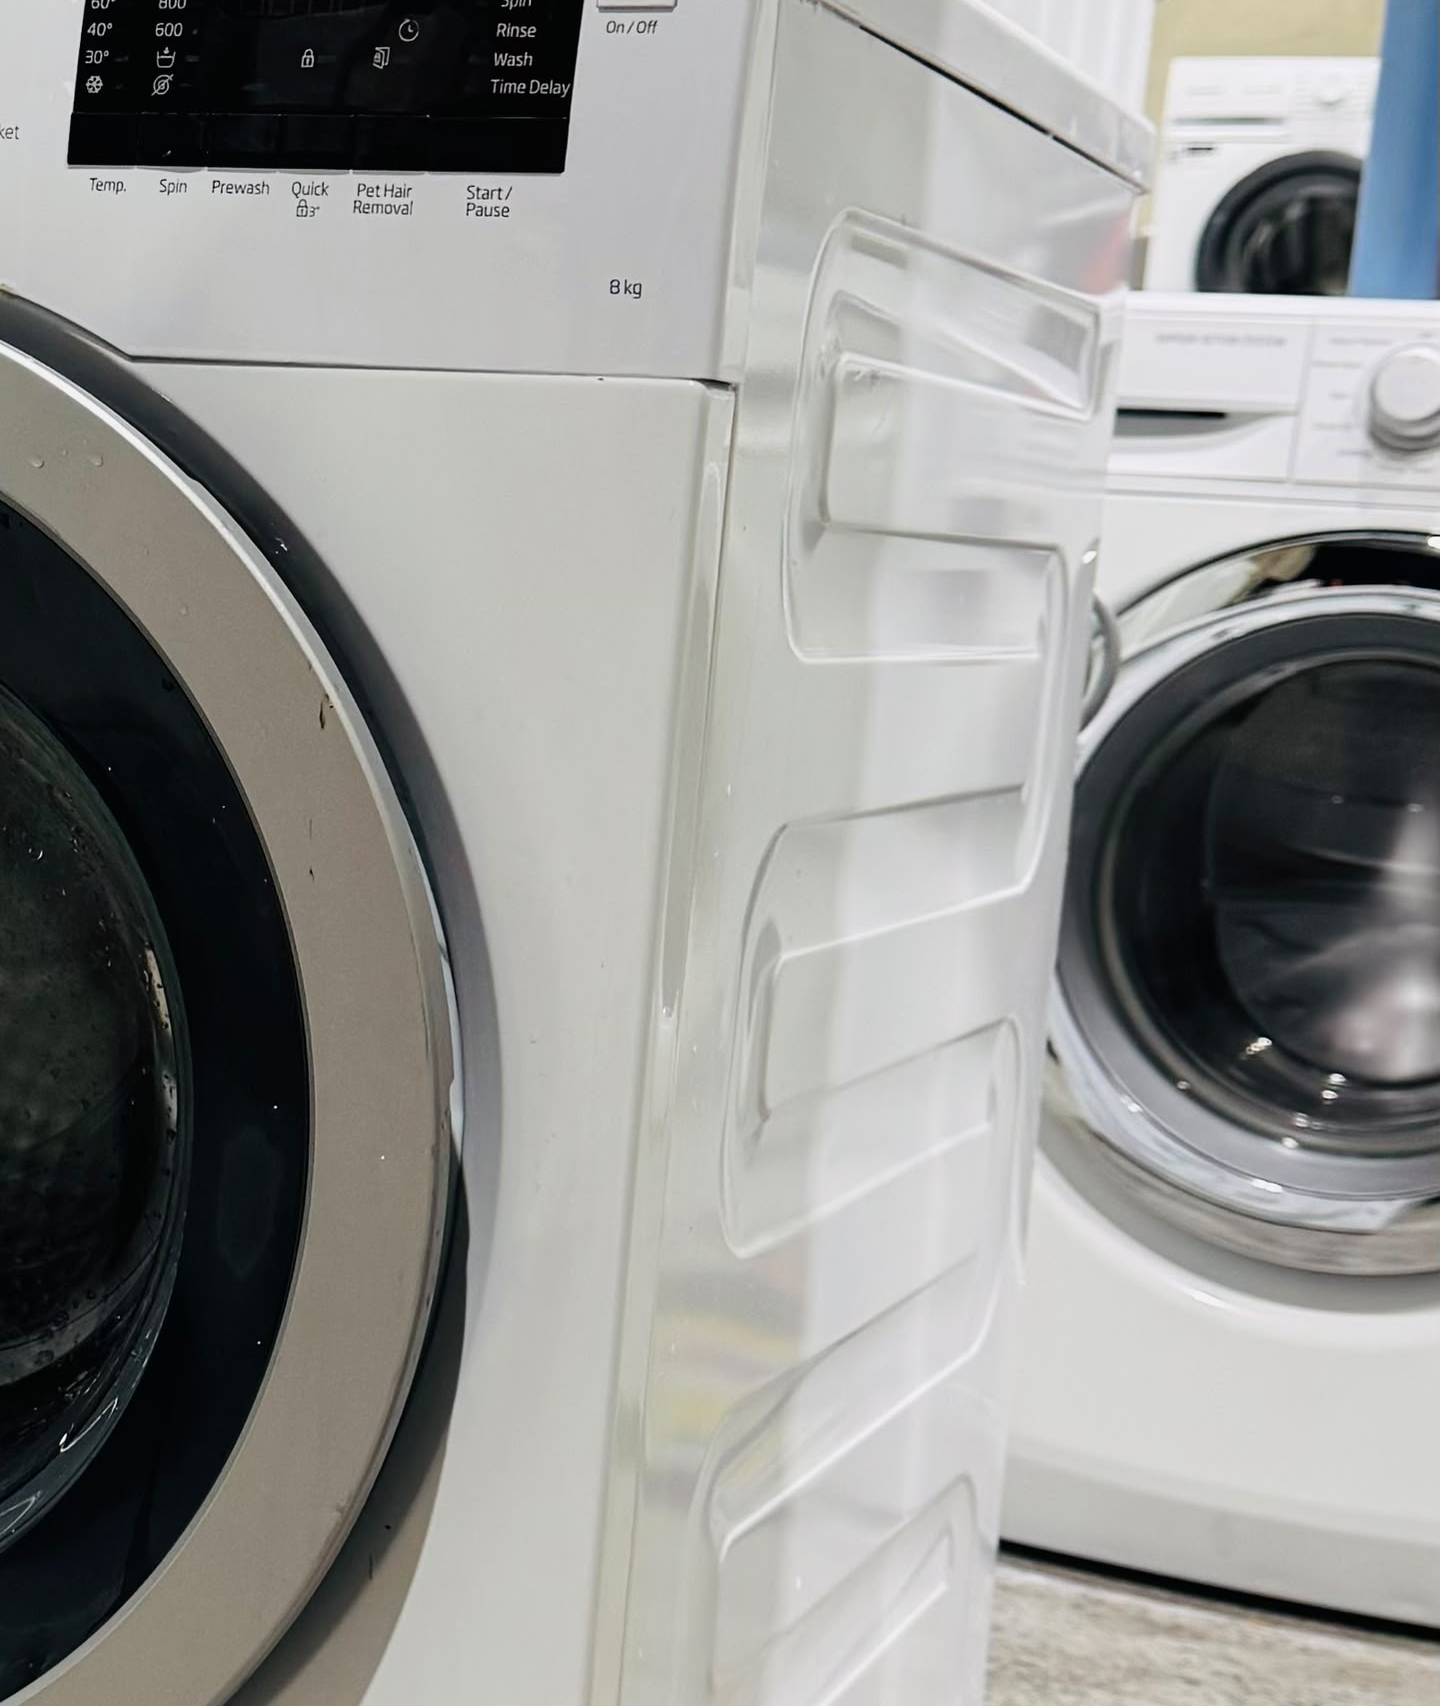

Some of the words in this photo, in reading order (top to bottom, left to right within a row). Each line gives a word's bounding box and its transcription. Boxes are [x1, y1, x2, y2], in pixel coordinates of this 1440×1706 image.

[87, 22, 113, 37] 40°
[155, 22, 184, 37] 600
[496, 23, 537, 39] Rinse
[606, 20, 625, 35] On
[636, 19, 659, 35] Off
[84, 50, 110, 65] 30°
[493, 52, 534, 68] Wash
[490, 79, 527, 95] Time
[528, 79, 571, 99] Delay
[89, 177, 127, 197] Temp.
[159, 178, 188, 196] Spin
[211, 180, 271, 196] Prewash
[291, 180, 329, 199] Quick
[356, 183, 381, 199] Pet
[383, 183, 413, 199] Hair
[466, 185, 503, 201] Start
[353, 200, 414, 216] Removal
[466, 202, 511, 219] Pause
[609, 278, 621, 295] 8
[623, 278, 643, 300] kg
